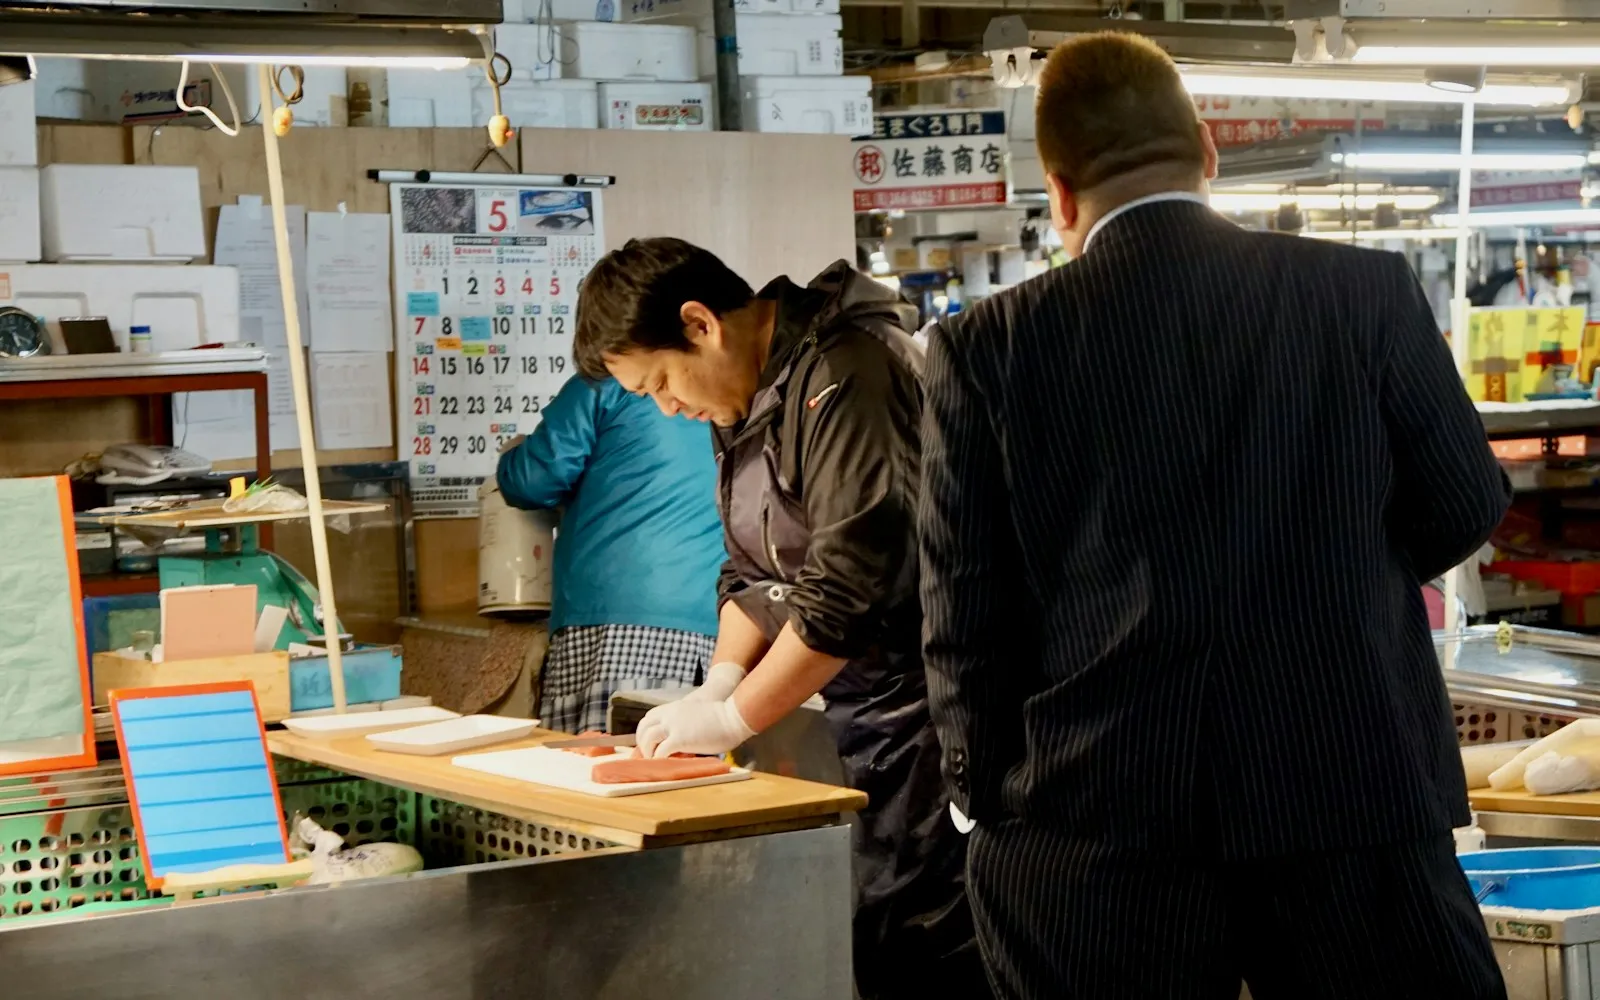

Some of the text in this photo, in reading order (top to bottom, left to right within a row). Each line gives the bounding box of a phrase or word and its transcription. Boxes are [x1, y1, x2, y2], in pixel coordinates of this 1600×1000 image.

[892, 143, 1001, 178] 佐藤商店
[488, 200, 508, 232] 5
[442, 277, 448, 295] 1
[467, 277, 478, 295] 2
[494, 278, 505, 296] 3
[521, 278, 533, 295] 4
[550, 278, 560, 295] 5
[415, 317, 426, 335] 7
[442, 316, 452, 335] 8
[492, 317, 510, 335] 10
[521, 317, 535, 334] 11
[548, 316, 564, 334] 12
[413, 356, 565, 375] 14 15 16 17 18 19
[414, 395, 539, 415] 21 22 23 24 25
[414, 436, 431, 455] 28
[440, 436, 458, 454] 29
[468, 435, 486, 453] 30
